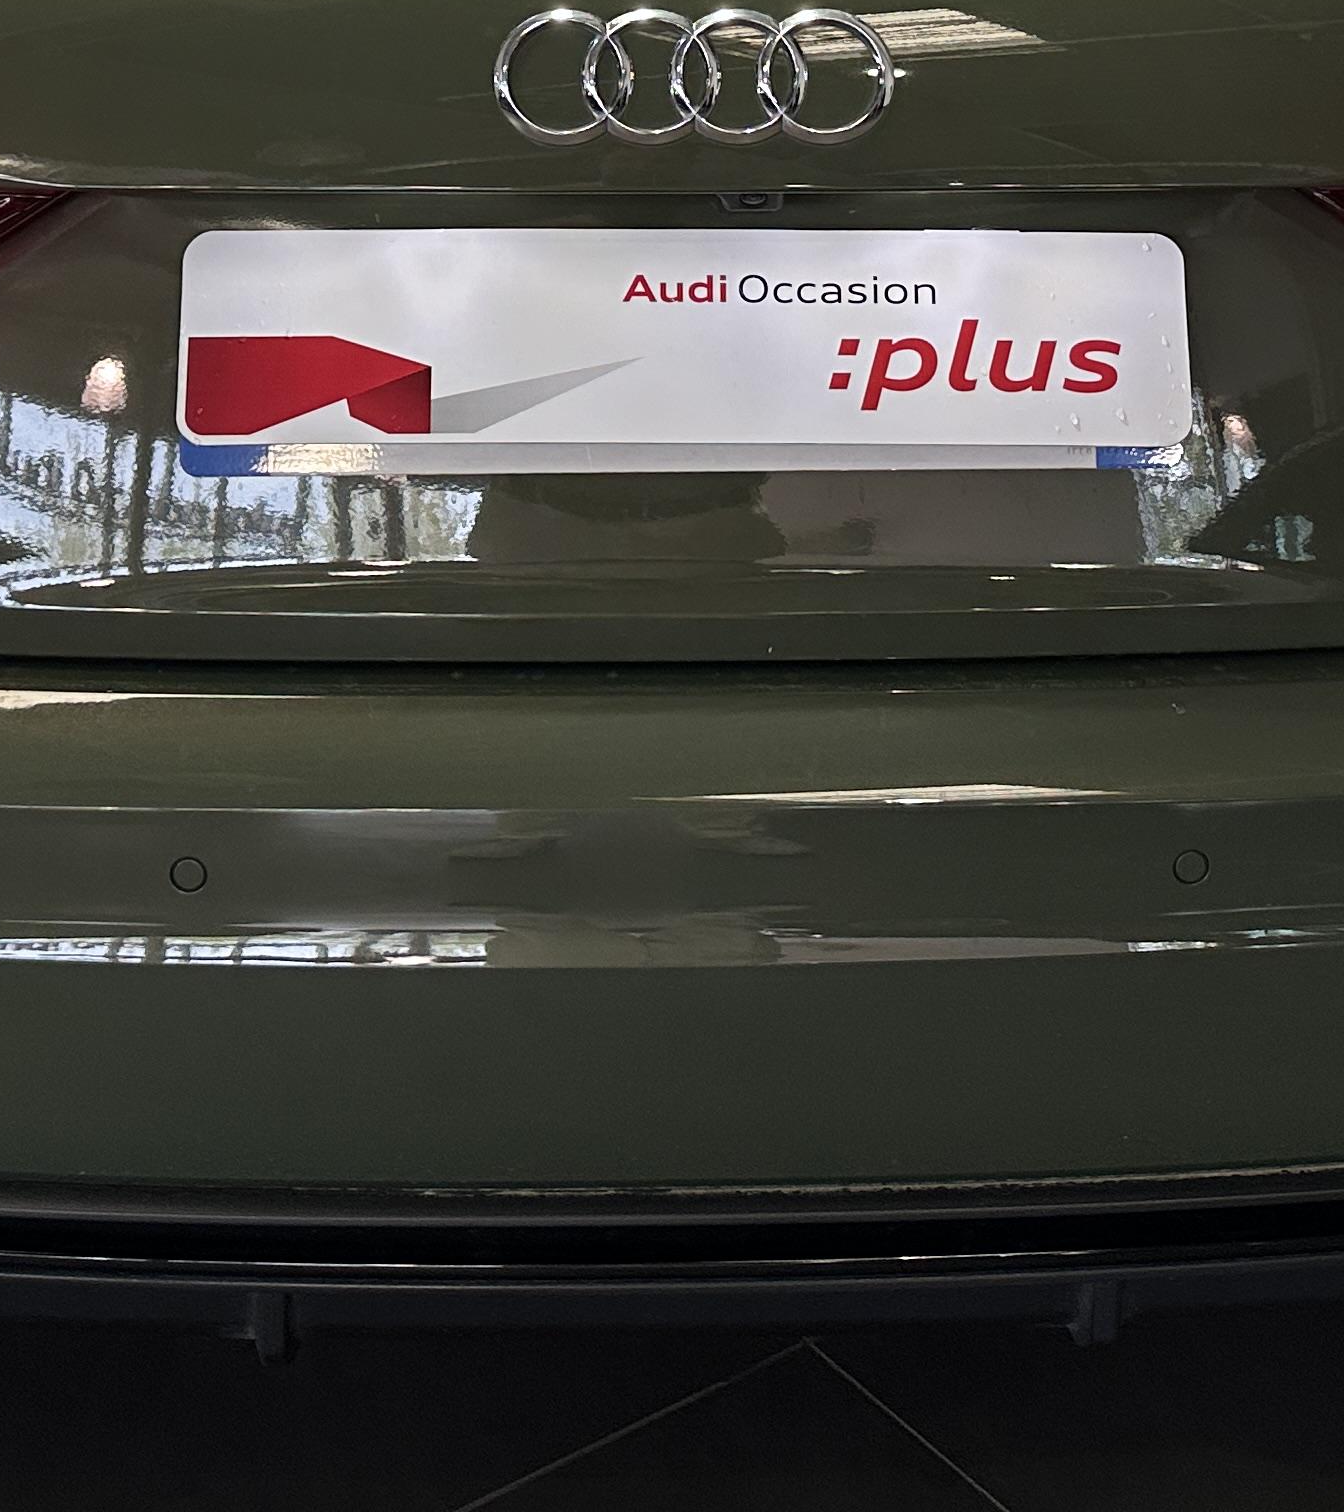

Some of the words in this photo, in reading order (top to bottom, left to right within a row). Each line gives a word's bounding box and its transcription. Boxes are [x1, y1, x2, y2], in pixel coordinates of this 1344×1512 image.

[623, 274, 728, 303] Audi
[737, 274, 937, 305] Occasion
[828, 318, 1122, 412] :plus
